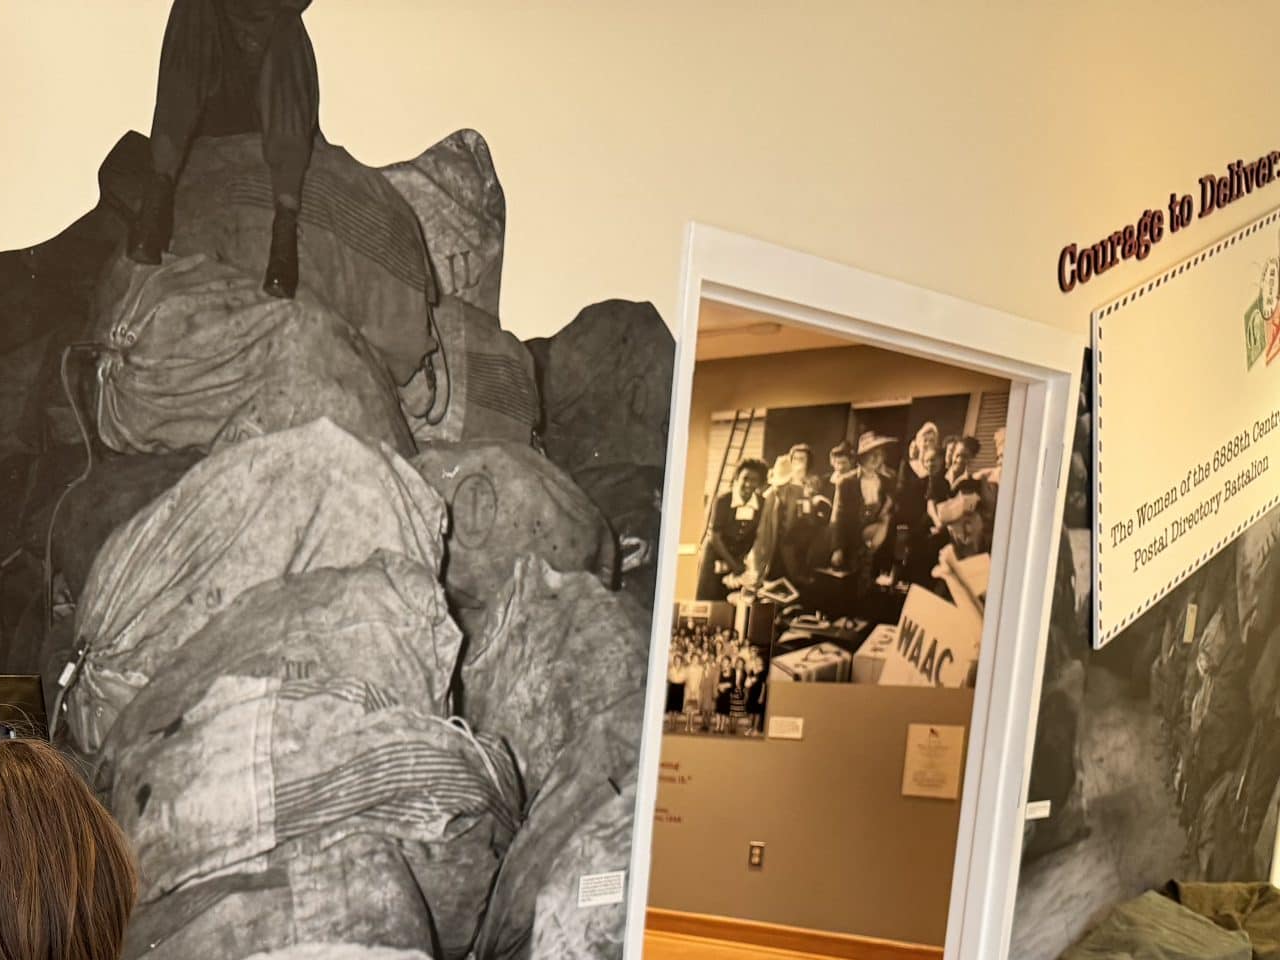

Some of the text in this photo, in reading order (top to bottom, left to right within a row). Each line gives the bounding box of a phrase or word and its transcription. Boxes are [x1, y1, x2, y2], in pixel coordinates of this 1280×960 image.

[1058, 209, 1164, 294] Courage
[1169, 193, 1193, 234] to
[1111, 410, 1280, 548] The Women of the 6888th Centr
[1133, 455, 1269, 573] Postal Directory Battalion
[897, 616, 954, 688] WAAC
